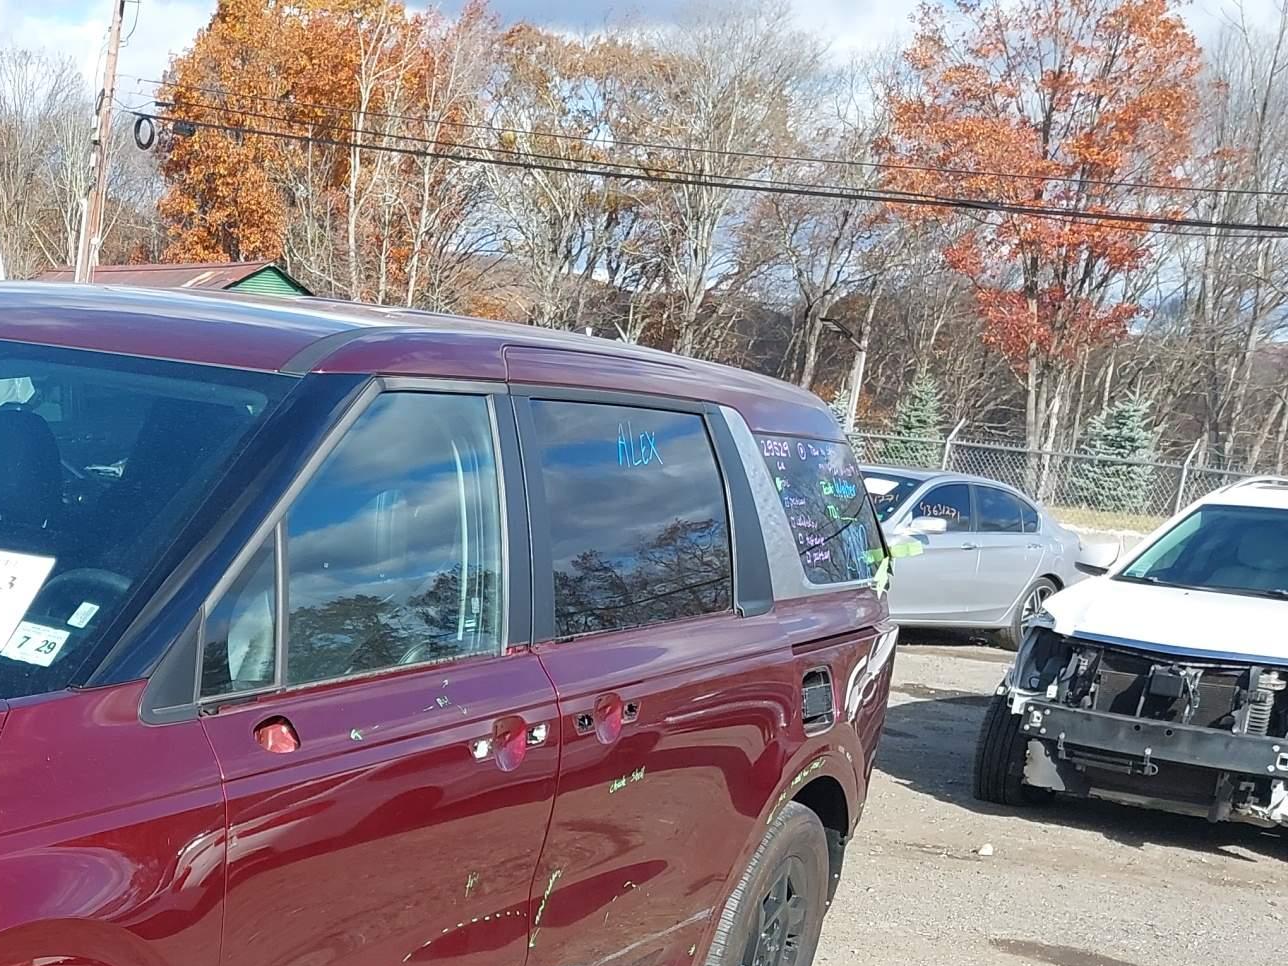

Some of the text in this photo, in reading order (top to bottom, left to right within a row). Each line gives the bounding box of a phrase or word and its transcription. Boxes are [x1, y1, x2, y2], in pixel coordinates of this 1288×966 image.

[617, 420, 664, 468] ALEX
[16, 635, 57, 655] 7 29
